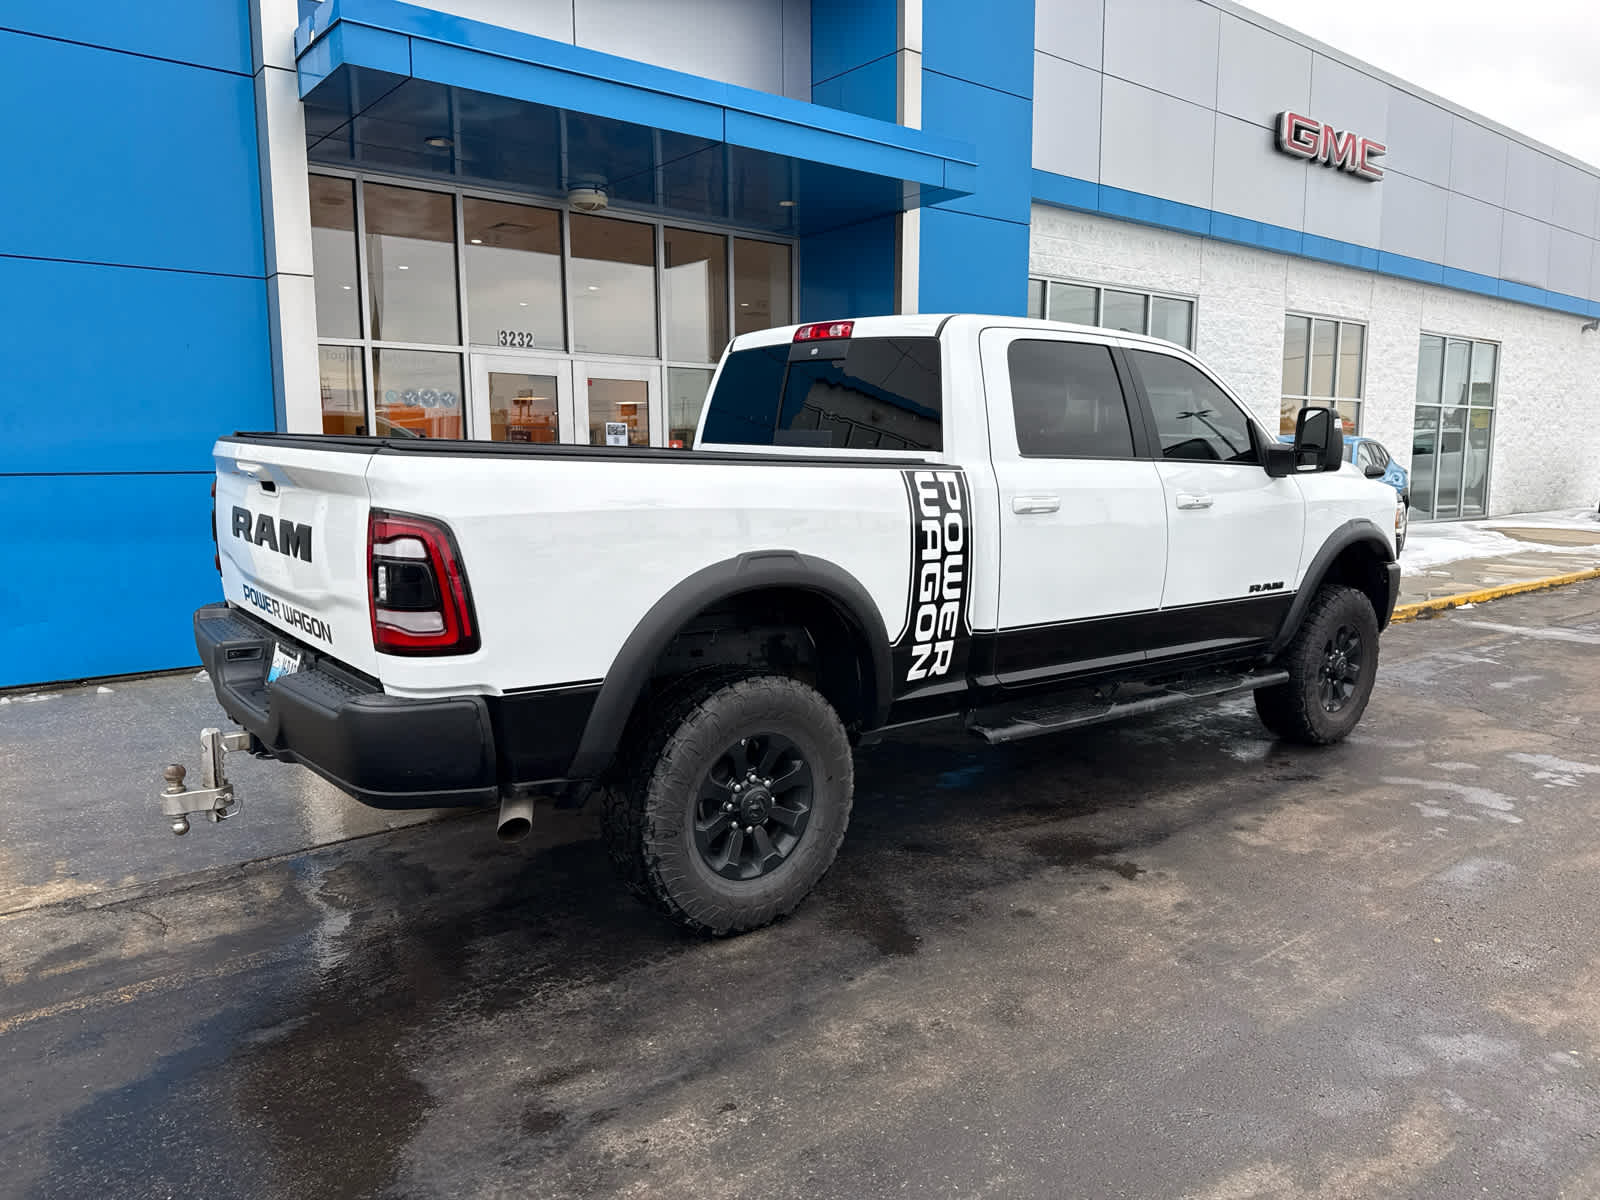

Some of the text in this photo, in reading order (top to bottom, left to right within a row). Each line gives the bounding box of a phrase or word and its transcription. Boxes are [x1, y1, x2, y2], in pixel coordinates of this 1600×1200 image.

[1278, 110, 1387, 182] GMC
[500, 330, 533, 348] 3232
[231, 505, 313, 563] RAM
[906, 471, 942, 682] WAGON
[928, 471, 964, 677] POWER
[1249, 581, 1284, 592] RAM
[242, 584, 333, 645] POWER WAGON
